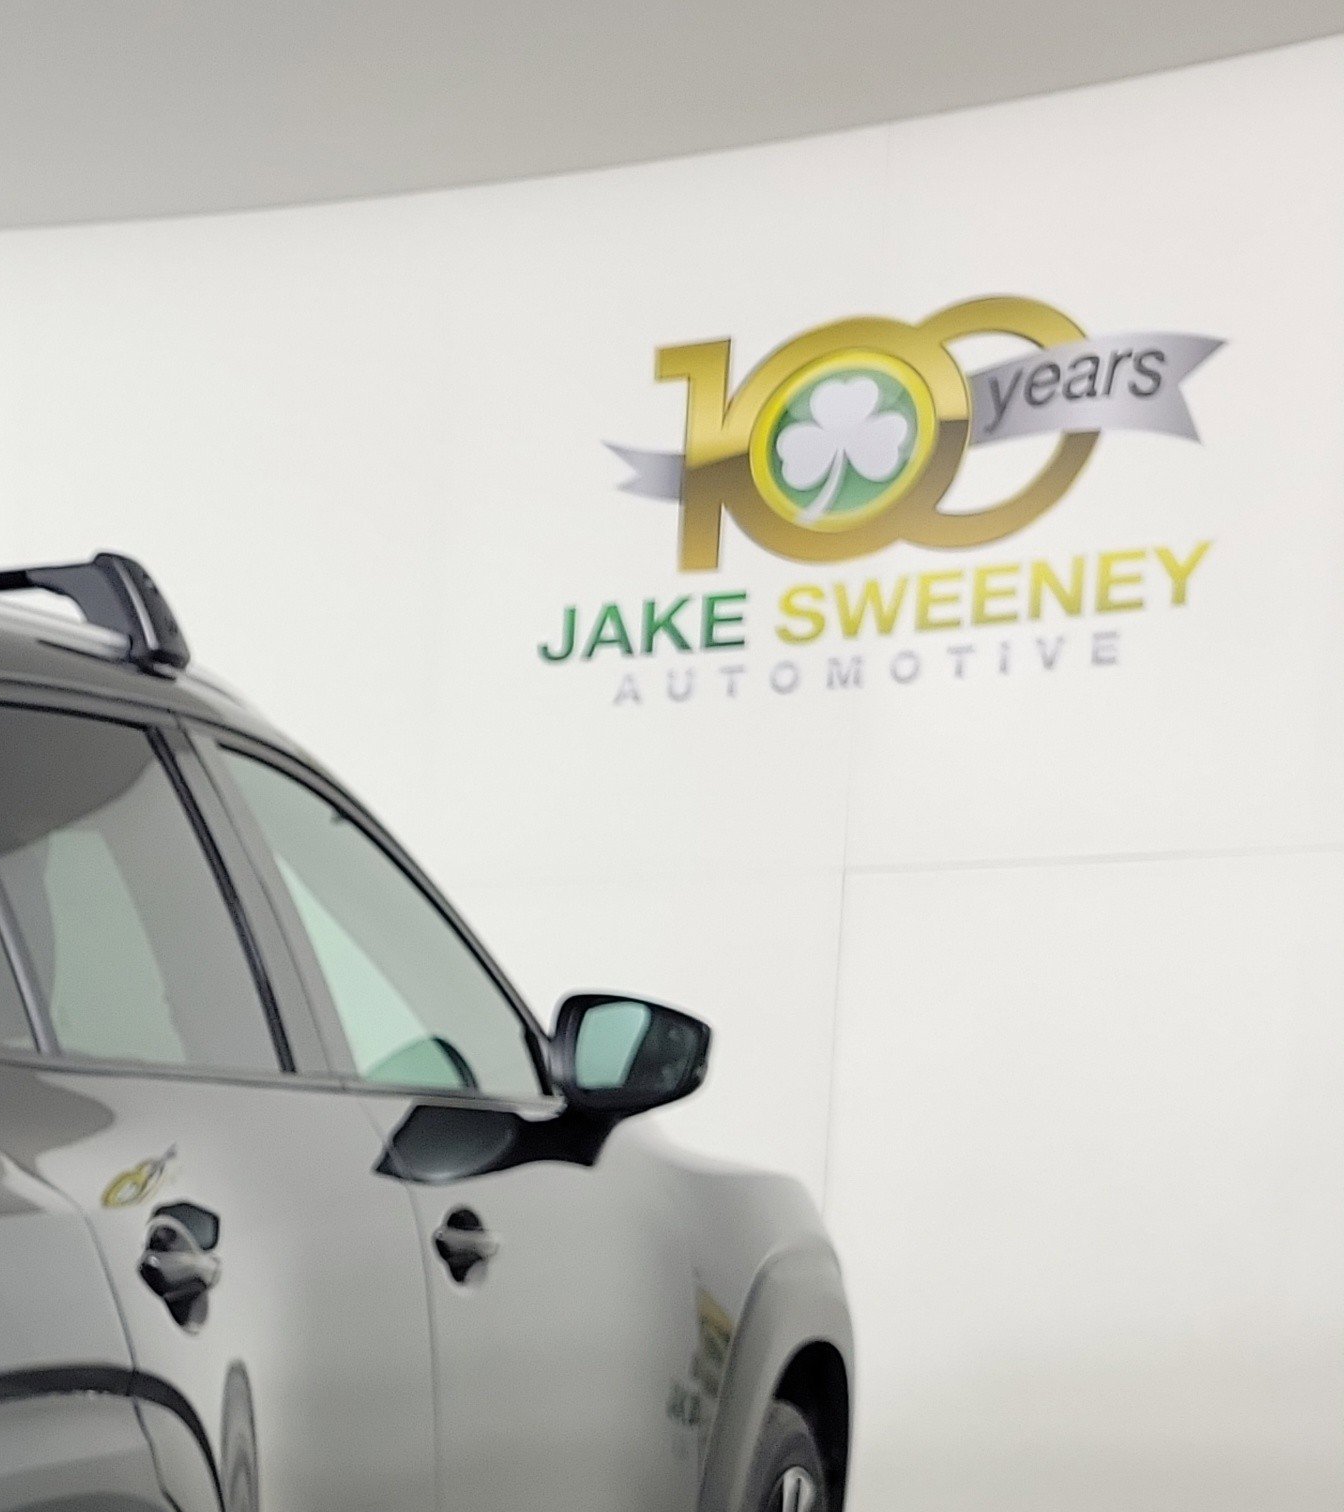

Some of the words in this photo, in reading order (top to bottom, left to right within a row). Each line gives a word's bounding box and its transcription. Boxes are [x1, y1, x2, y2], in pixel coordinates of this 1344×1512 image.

[654, 292, 1101, 572] 100
[982, 341, 1167, 435] years
[537, 589, 749, 666] JAKE
[774, 540, 1214, 646] SWEENEY
[612, 629, 1122, 708] AUTOMOTIVE
